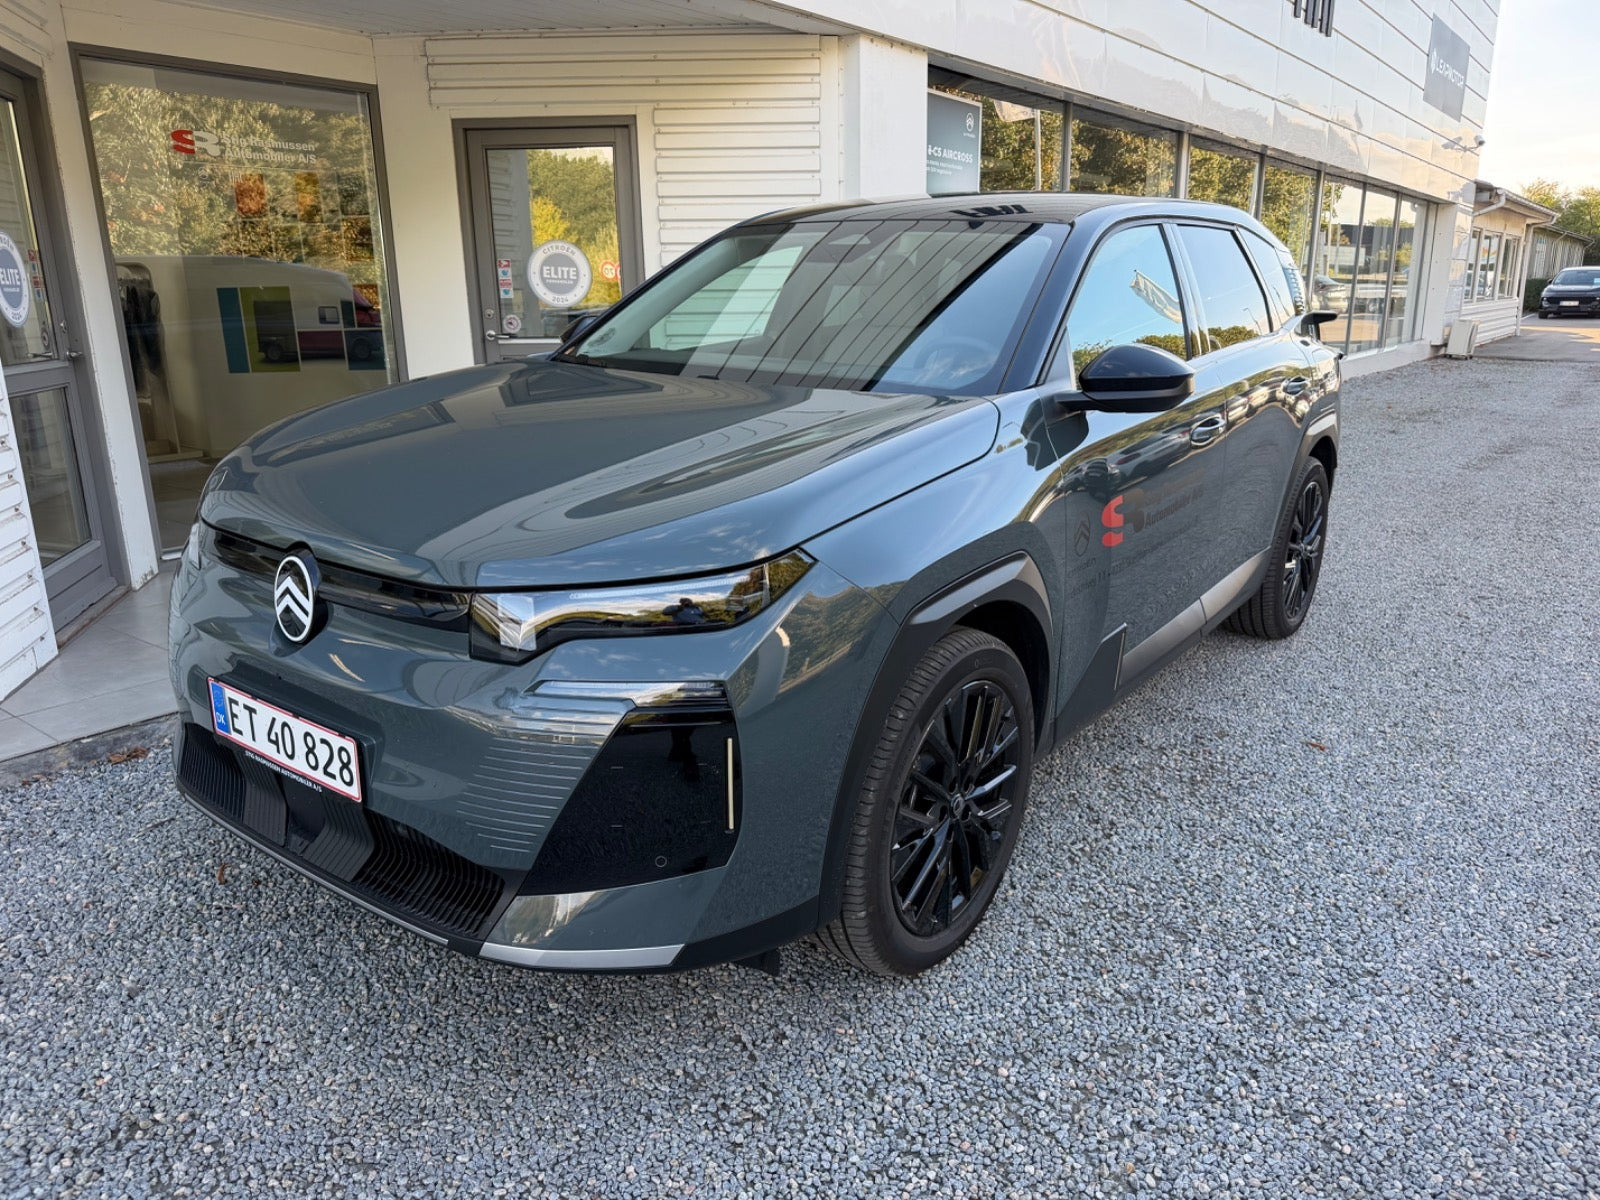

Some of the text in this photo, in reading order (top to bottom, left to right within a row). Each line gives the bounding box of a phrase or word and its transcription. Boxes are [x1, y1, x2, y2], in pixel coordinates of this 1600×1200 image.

[249, 137, 316, 151] Rasmussen
[224, 148, 317, 165] Automobiler A/S
[942, 149, 973, 163] AIRCROSS
[0, 268, 21, 285] ELITE
[542, 266, 577, 280] ELITE
[215, 711, 226, 726] DK
[227, 696, 354, 787] ET 40 828
